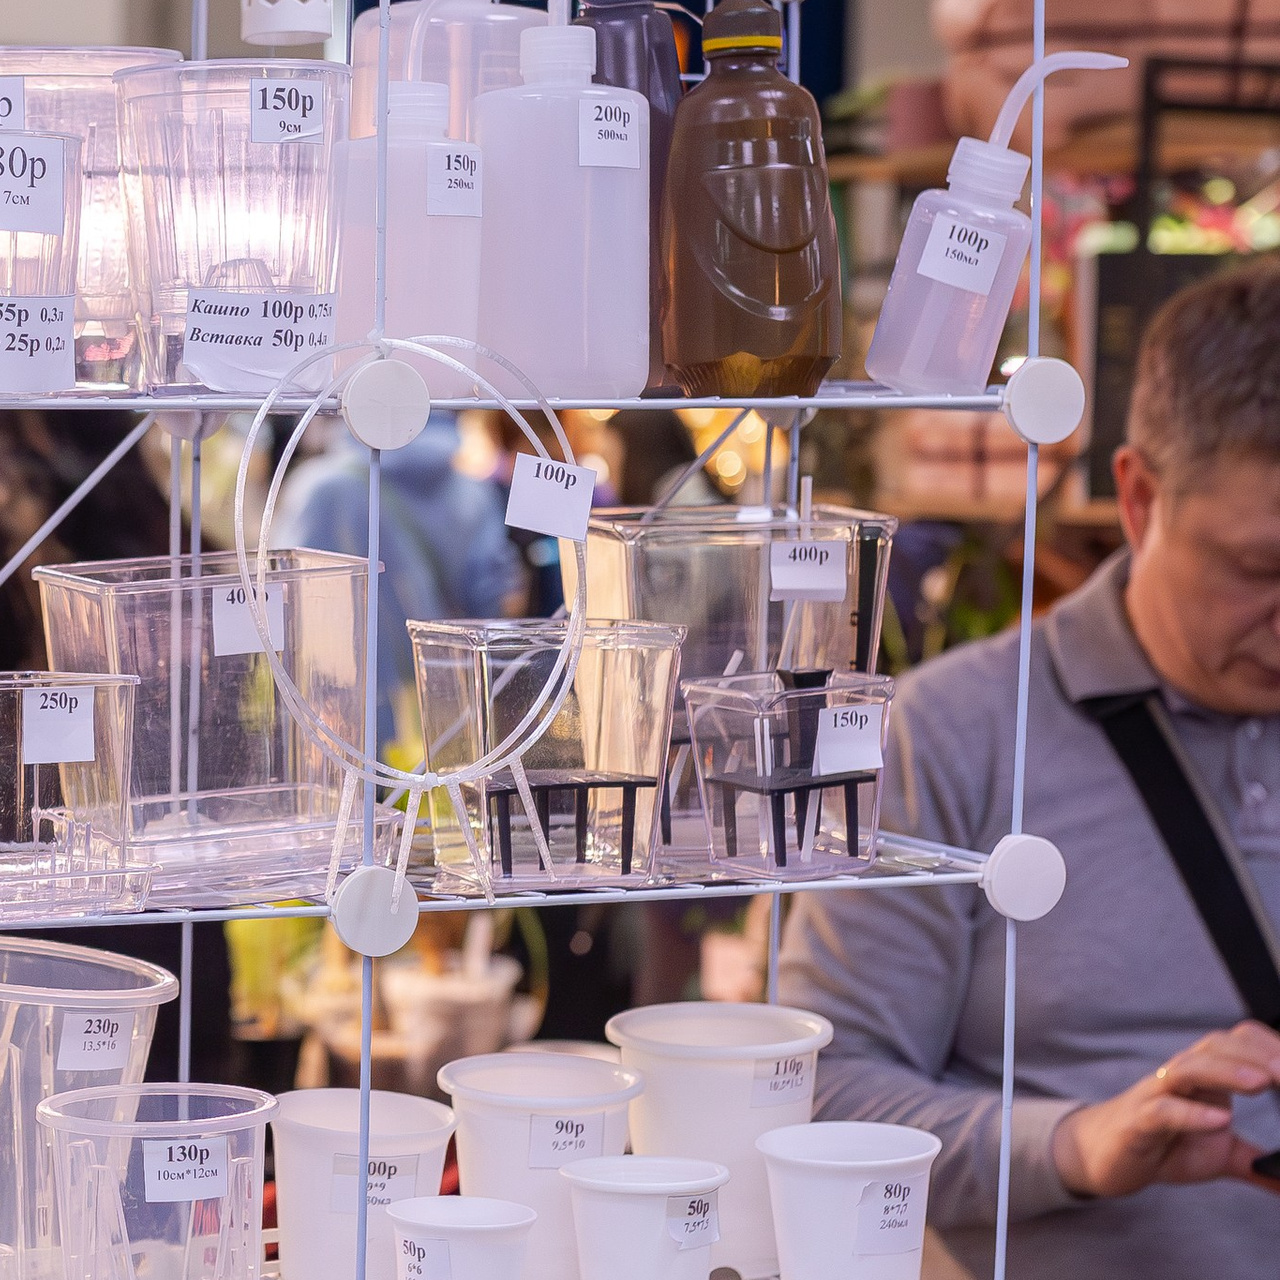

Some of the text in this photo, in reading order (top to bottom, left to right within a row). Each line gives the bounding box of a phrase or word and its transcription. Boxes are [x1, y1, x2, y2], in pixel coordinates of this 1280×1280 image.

[257, 87, 314, 119] 150р
[594, 105, 631, 128] 200р
[278, 121, 302, 134] 9см
[597, 129, 628, 141] 500мл
[445, 154, 477, 177] 150р
[447, 178, 475, 190] 250мл
[2, 190, 31, 206] 7см
[947, 224, 989, 254] 100р
[944, 246, 979, 267] 150мл
[39, 307, 64, 324] 0,3л
[190, 298, 251, 318] Кашпо
[260, 300, 305, 324] 100р
[4, 333, 41, 357] 25р
[45, 336, 66, 353] 0,2л
[188, 327, 263, 348] Вставка
[271, 329, 305, 352] 50р
[532, 462, 577, 491] 100р
[788, 546, 829, 566] 400р
[39, 691, 79, 714] 250р
[832, 710, 869, 730] 150р
[82, 1018, 119, 1038] 230р
[774, 1058, 803, 1075] 110р
[555, 1119, 584, 1138] 90р
[166, 1144, 210, 1165] 130р
[367, 1161, 398, 1180] 00р
[883, 1182, 911, 1202] 80р
[687, 1199, 710, 1218] 50р
[403, 1239, 426, 1262] 50р
